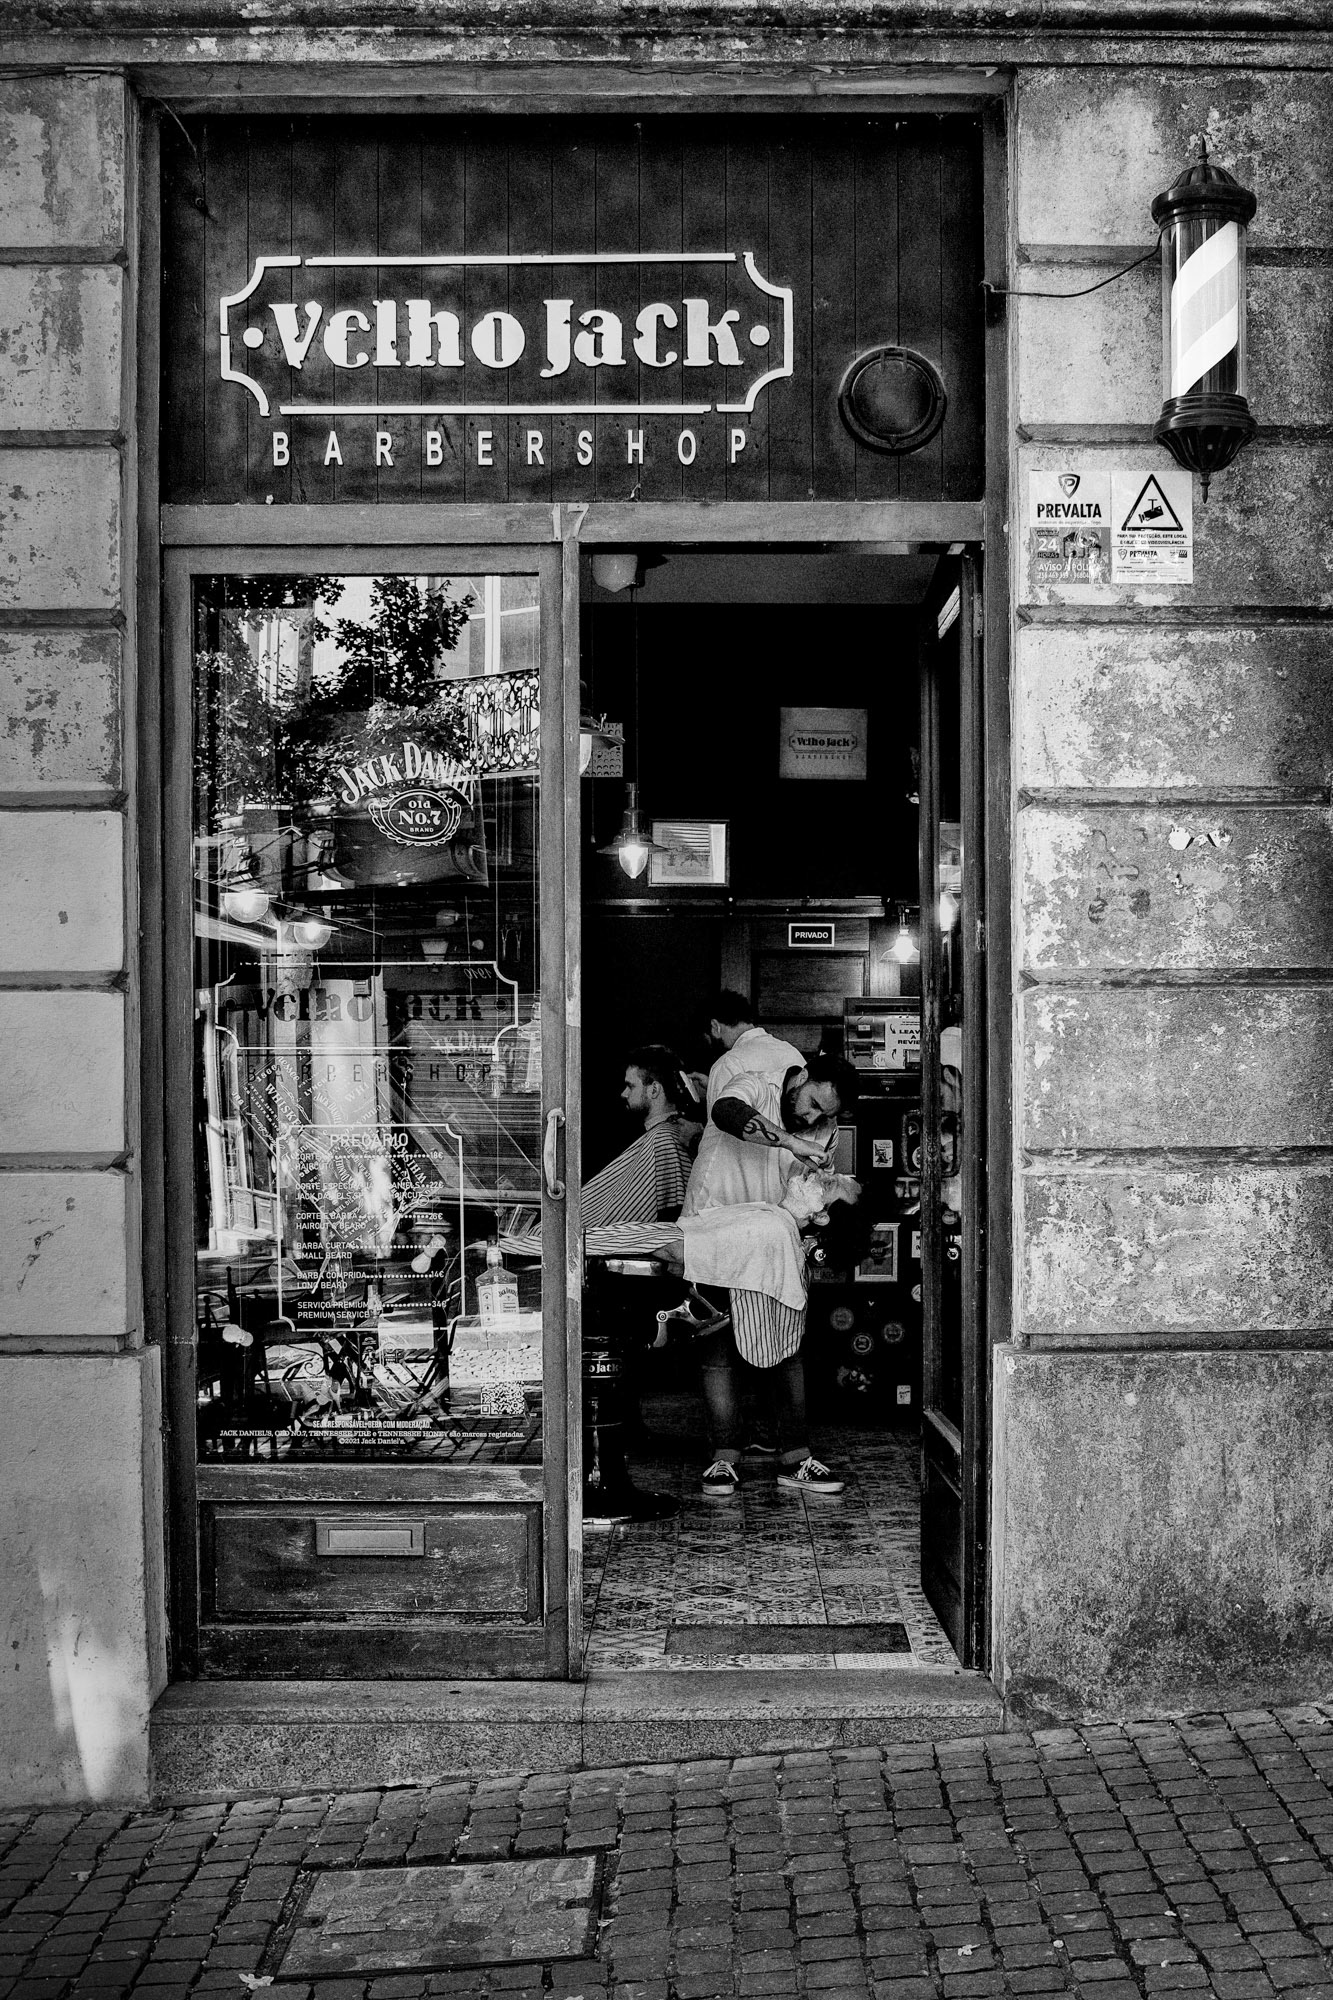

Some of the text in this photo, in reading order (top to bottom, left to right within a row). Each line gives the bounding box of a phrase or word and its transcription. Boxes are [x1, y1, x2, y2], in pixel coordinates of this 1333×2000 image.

[270, 298, 745, 378] Velho Jack
[271, 428, 746, 468] BARBERSHOP
[1037, 503, 1102, 518] PREVALTA
[1038, 538, 1058, 551] 24
[1039, 563, 1062, 571] AVISO
[338, 752, 404, 804] JACK
[408, 800, 431, 809] Old
[398, 810, 441, 826] No.7
[795, 931, 829, 939] PRIVADO
[429, 1150, 444, 1159] 18€
[296, 1182, 321, 1190] CORTE
[429, 1180, 444, 1189] 22€
[295, 1192, 316, 1200] JACK
[296, 1212, 321, 1220] CORTE
[296, 1222, 329, 1230] HAIRCUT
[296, 1241, 324, 1250] BARBA
[325, 1241, 352, 1250] CURTA
[296, 1252, 353, 1260] SMALL BEARD
[296, 1270, 445, 1280] BARBA COMPRIDA 14€
[296, 1281, 348, 1289] LONG BEARD
[297, 1301, 332, 1310] SERVIÇO
[332, 1301, 369, 1309] PREMIUM
[297, 1311, 370, 1319] PREMIUM SERVICE
[383, 1420, 396, 1429] COM
